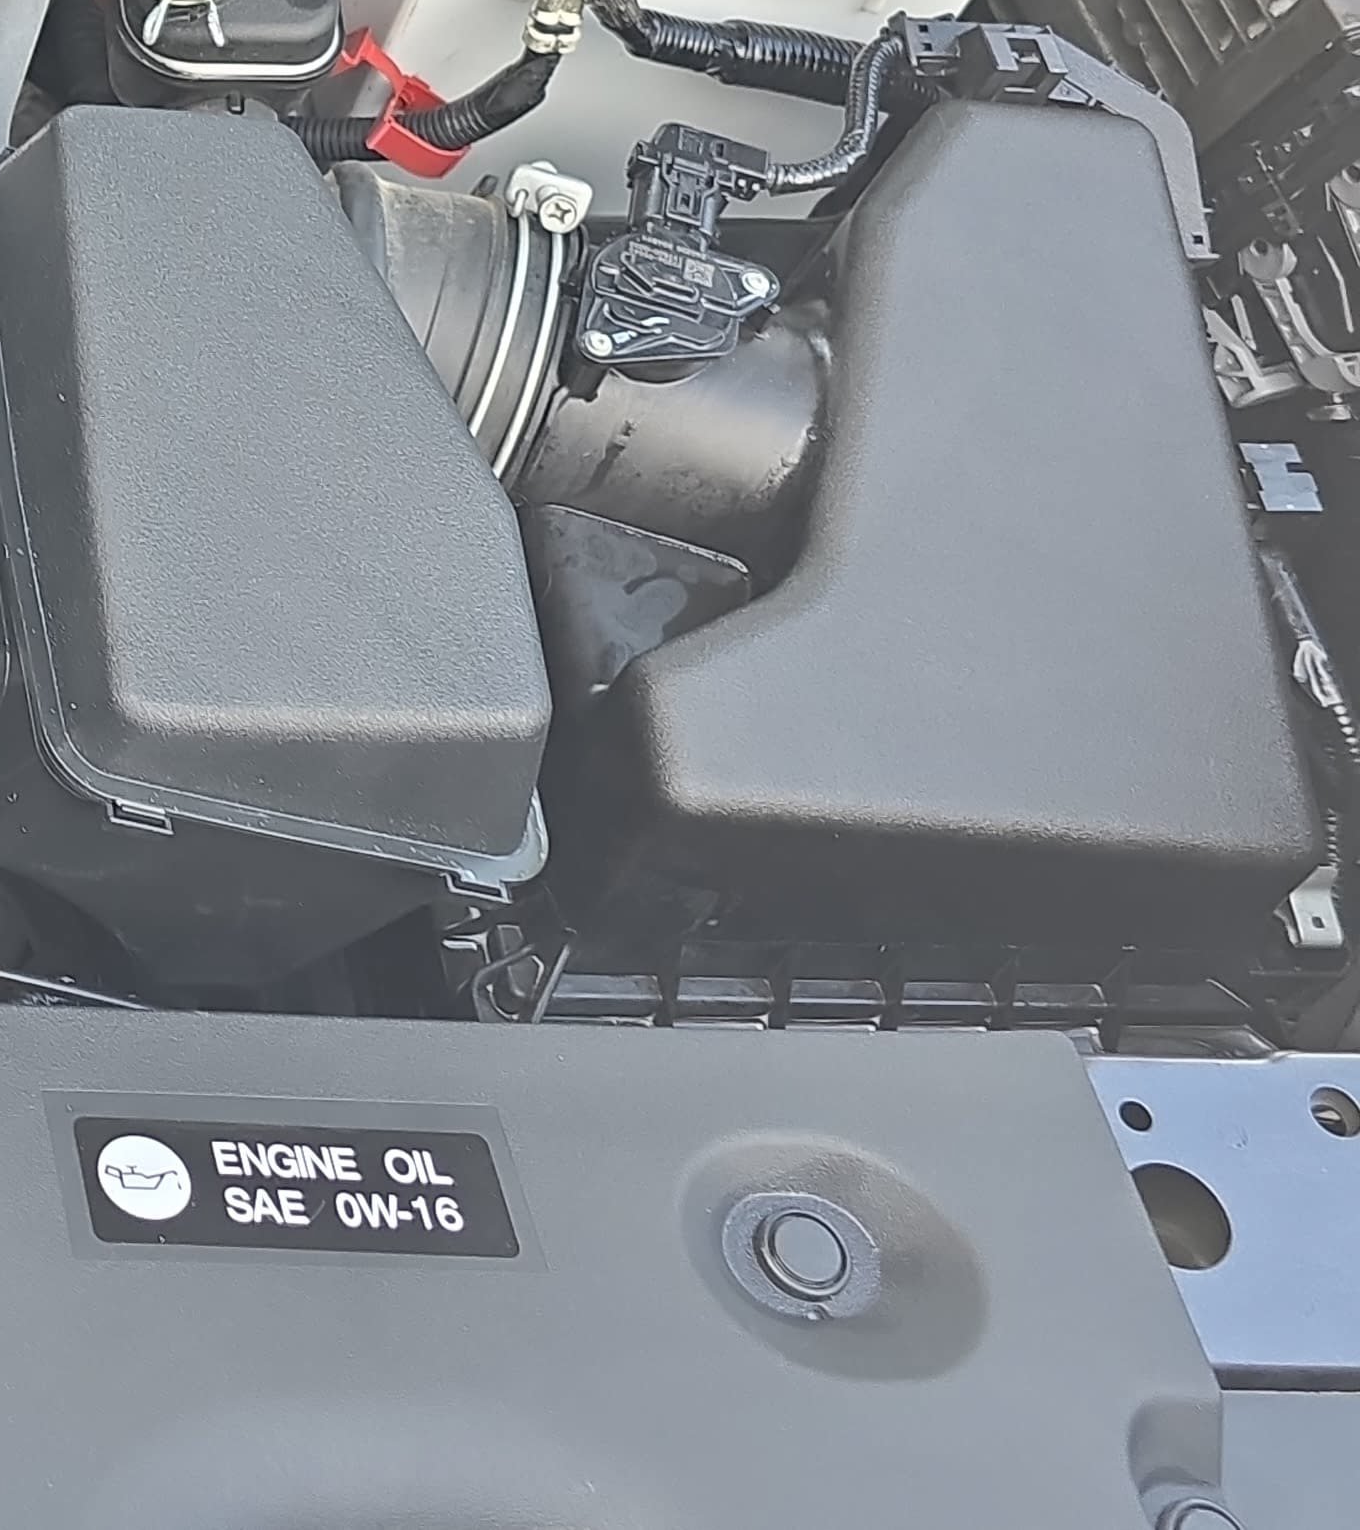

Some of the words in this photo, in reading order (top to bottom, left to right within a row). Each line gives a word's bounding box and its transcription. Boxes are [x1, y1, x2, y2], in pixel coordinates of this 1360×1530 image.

[211, 1140, 362, 1182] ENGINE
[383, 1149, 454, 1187] OIL
[223, 1186, 311, 1227] SAE
[335, 1192, 465, 1233] 0W-16
